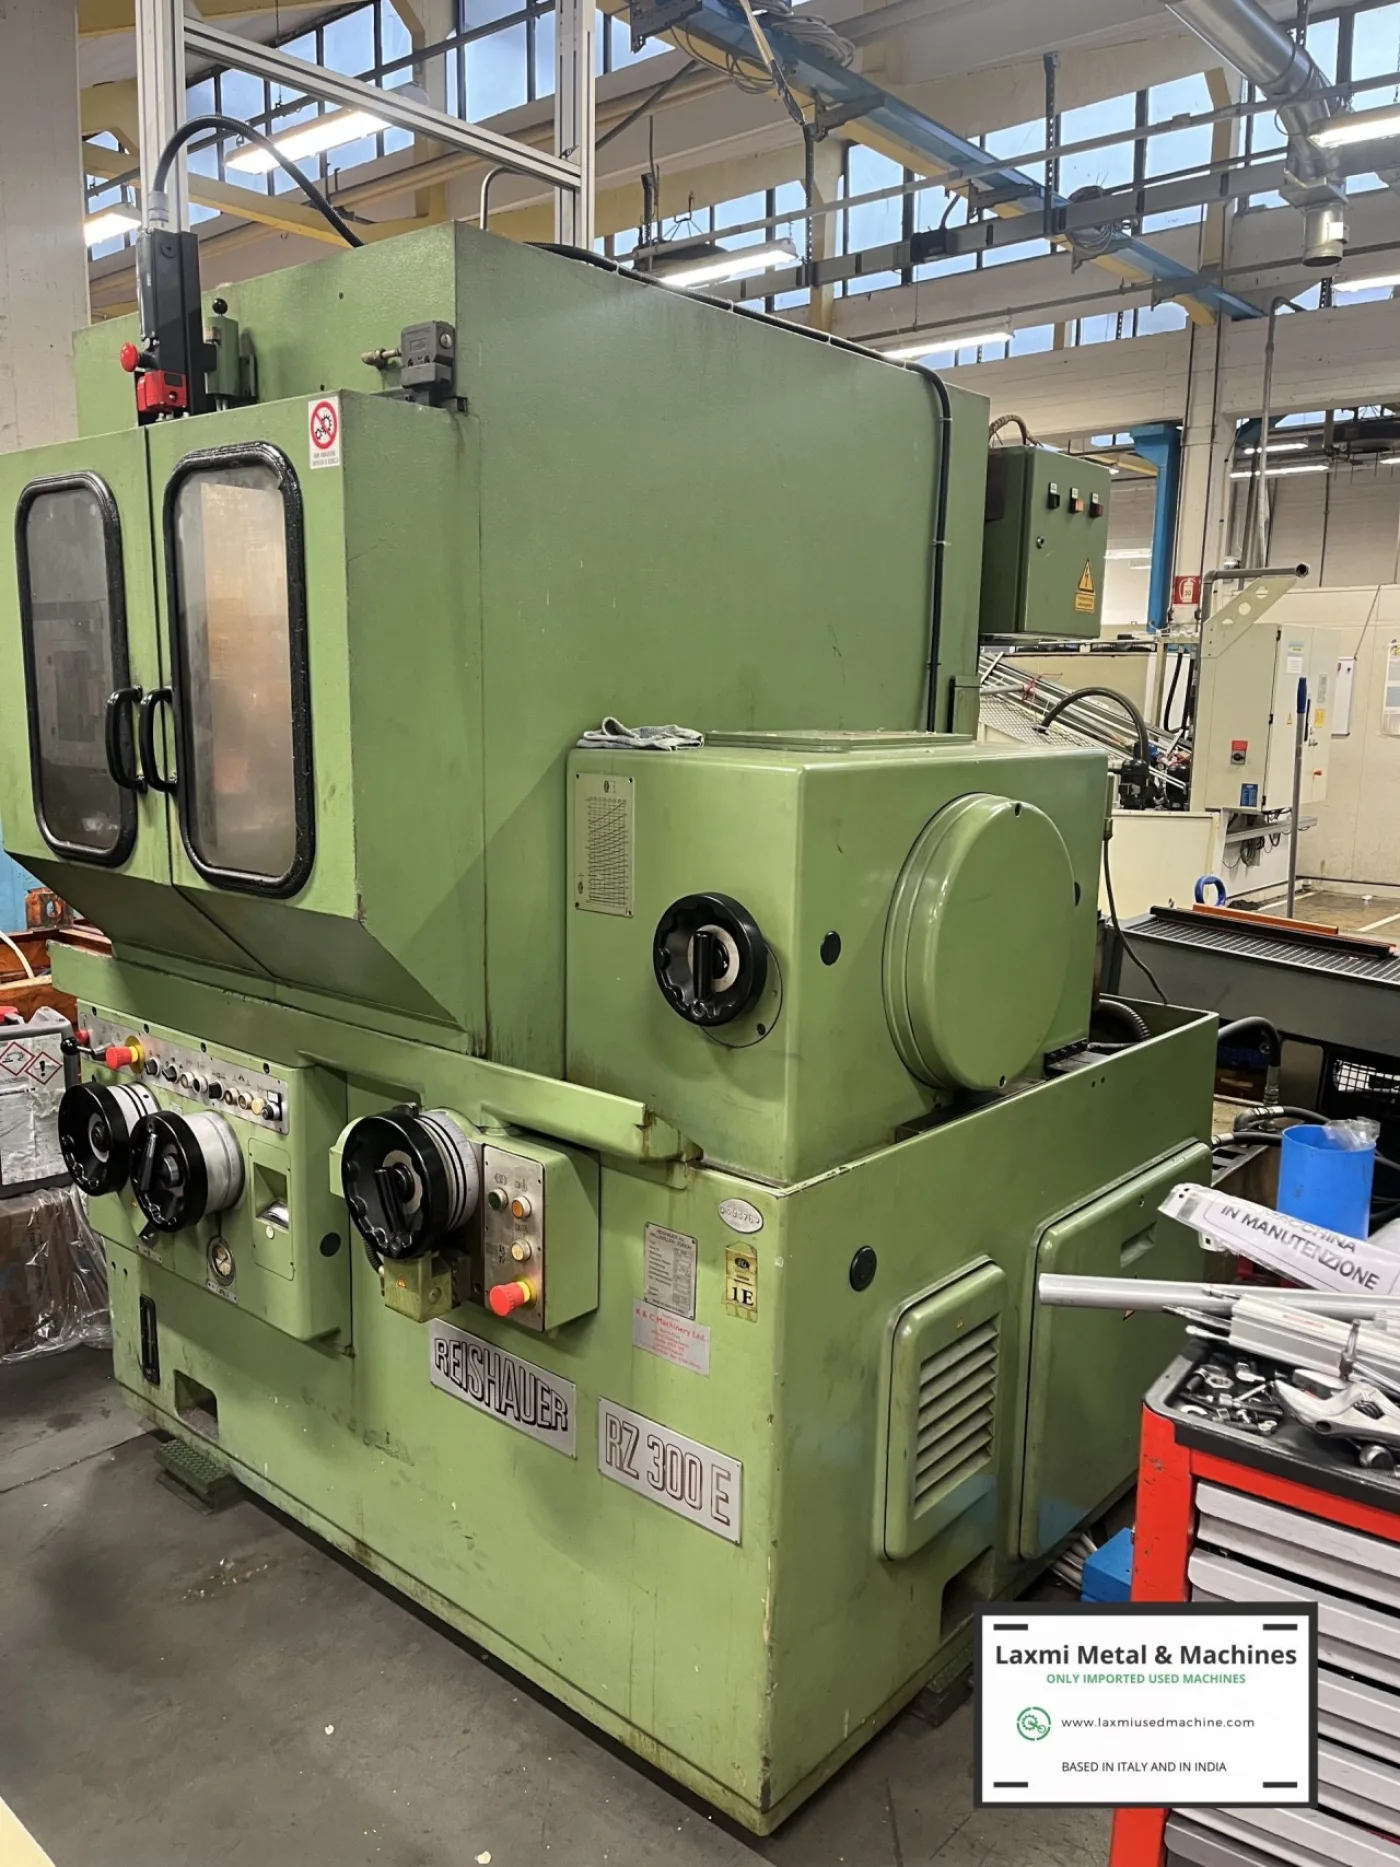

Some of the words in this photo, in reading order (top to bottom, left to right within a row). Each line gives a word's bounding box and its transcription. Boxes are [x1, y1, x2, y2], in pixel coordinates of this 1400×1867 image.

[1220, 1204, 1240, 1220] IN
[1241, 1213, 1380, 1291] MANUTENZIONE
[1263, 1206, 1356, 1252] ACCHINA
[656, 1315, 691, 1336] Machinery
[434, 1337, 569, 1432] REISHAUER
[605, 1412, 640, 1480] RZ
[646, 1433, 703, 1511] 300
[710, 1462, 731, 1527] E
